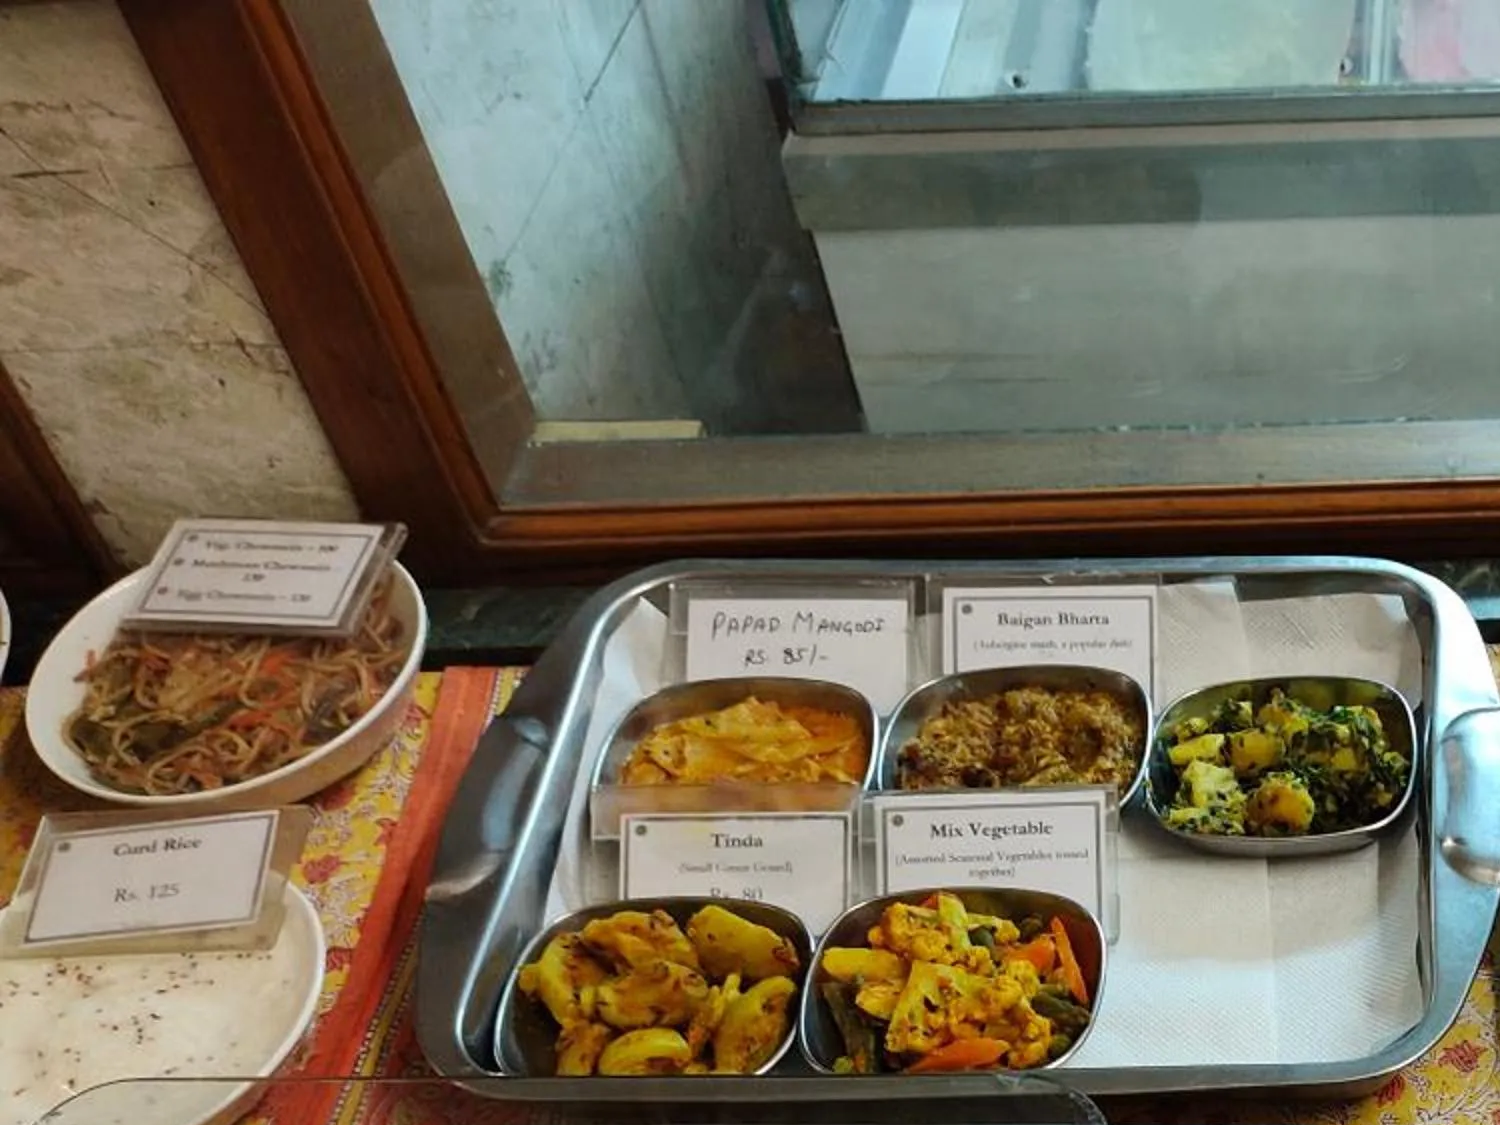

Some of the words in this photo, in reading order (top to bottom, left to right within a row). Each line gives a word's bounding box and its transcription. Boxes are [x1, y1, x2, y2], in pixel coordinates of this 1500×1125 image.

[711, 611, 781, 641] PAPAD
[998, 611, 1052, 630] Baigan
[1058, 611, 1110, 626] Bharta
[930, 823, 964, 839] Mix
[968, 820, 1053, 840] Vegetable
[113, 839, 158, 857] Curd
[163, 837, 203, 852] Rice
[710, 832, 763, 849] Tinda
[114, 886, 139, 903] Rs.
[148, 883, 181, 899] 125
